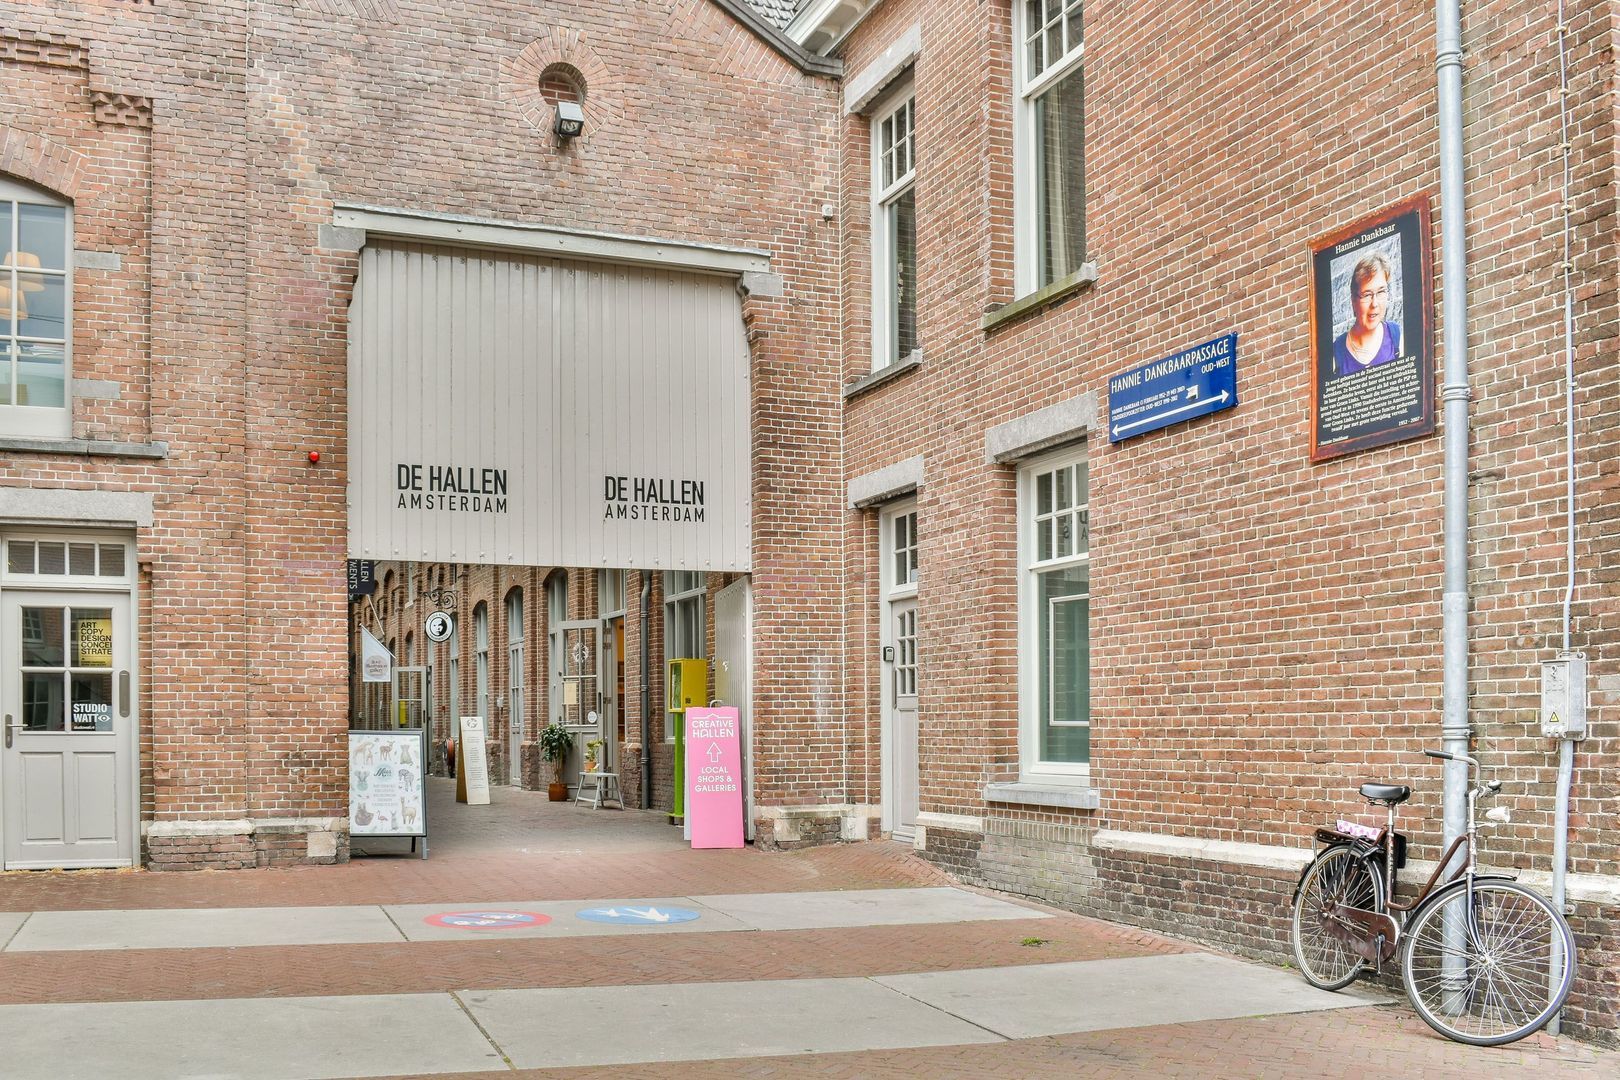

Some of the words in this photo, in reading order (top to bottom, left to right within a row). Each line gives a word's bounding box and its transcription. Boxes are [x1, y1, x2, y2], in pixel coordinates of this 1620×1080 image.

[1335, 238, 1360, 254] Hannie
[1361, 224, 1396, 243] Dankbaar
[1111, 371, 1141, 394] HANNIE
[1145, 338, 1229, 382] DANKBAARPASSAGE
[1202, 356, 1230, 374] OUD-WEST
[398, 464, 422, 491] DE
[430, 466, 506, 495] HALLEN
[605, 476, 628, 501] DE
[634, 478, 704, 505] HALLEN
[398, 493, 506, 513] AMSTERDAM
[605, 504, 704, 522] AMSTERDAM
[361, 560, 369, 582] LLEN
[73, 704, 108, 712] STUDIO
[73, 714, 99, 722] WATT
[692, 720, 734, 728] CREATIVE
[692, 729, 734, 738] HALLEN
[702, 766, 728, 774] LOCAL
